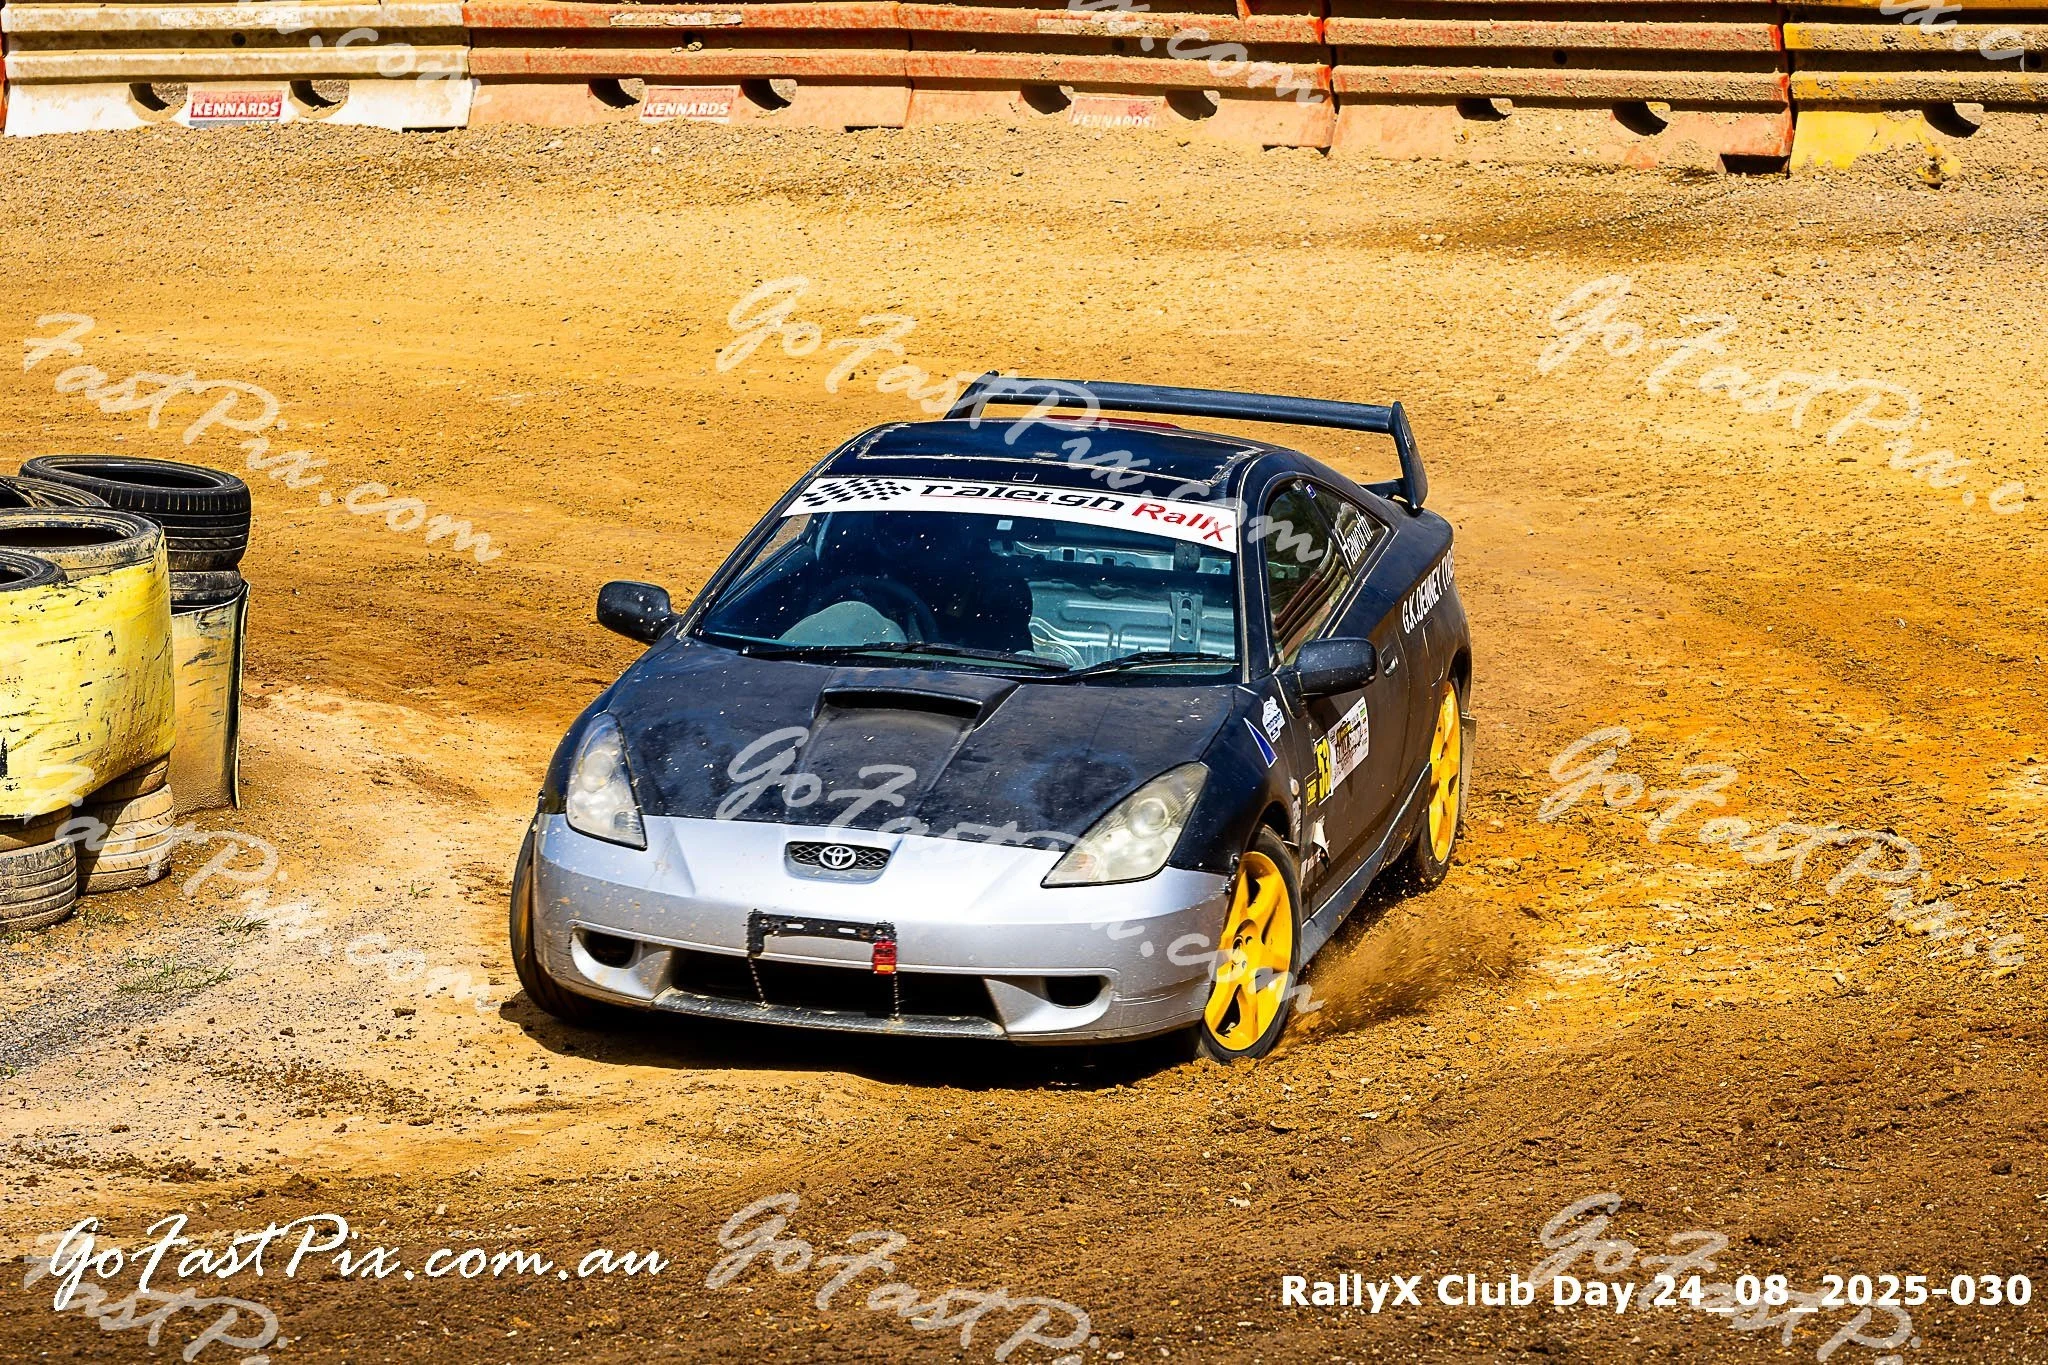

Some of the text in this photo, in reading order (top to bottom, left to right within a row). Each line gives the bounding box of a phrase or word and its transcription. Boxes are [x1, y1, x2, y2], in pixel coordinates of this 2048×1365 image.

[192, 101, 280, 117] KENNARDS
[645, 102, 729, 116] KENNARDS
[921, 484, 1124, 511] raleigh
[1335, 510, 1373, 570] Haworth
